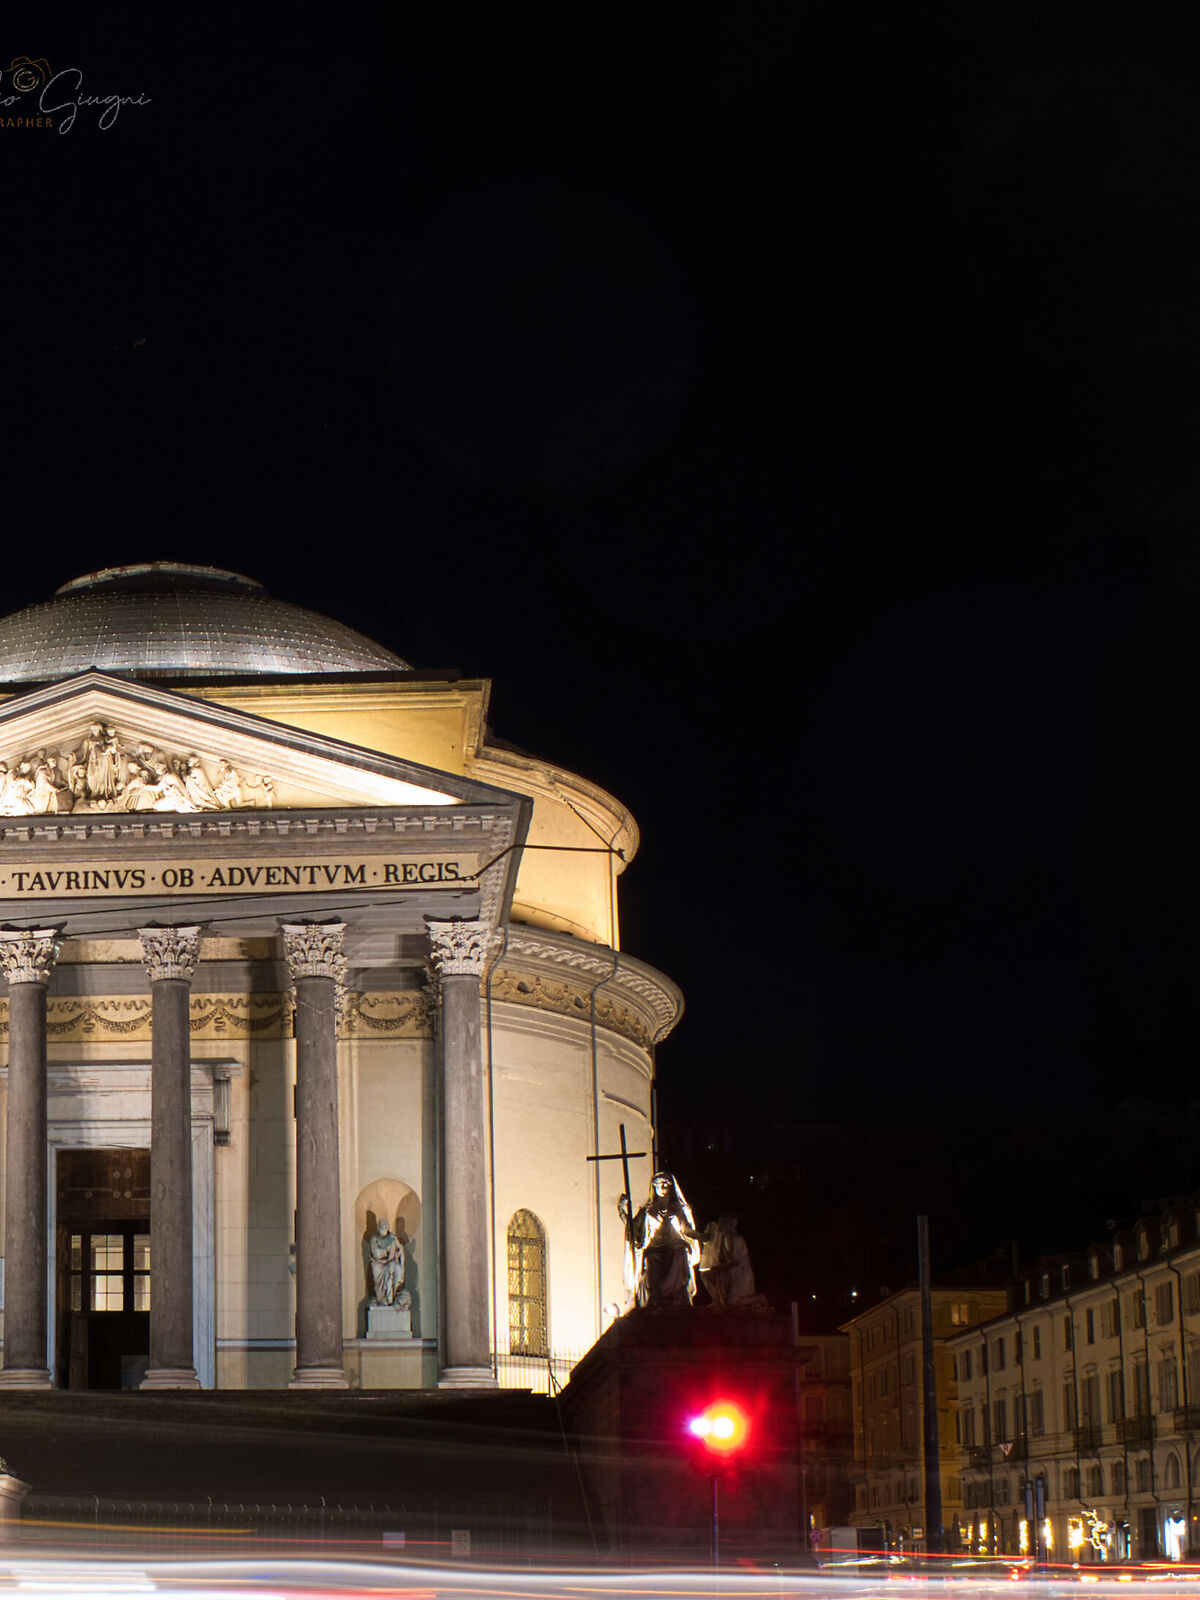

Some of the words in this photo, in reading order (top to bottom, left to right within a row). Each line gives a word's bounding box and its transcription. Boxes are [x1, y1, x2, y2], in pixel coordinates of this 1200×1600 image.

[12, 869, 145, 892] TAVRINVS
[161, 867, 194, 888] OB
[207, 864, 367, 887] ADVENTVM
[383, 861, 460, 884] REGIS
